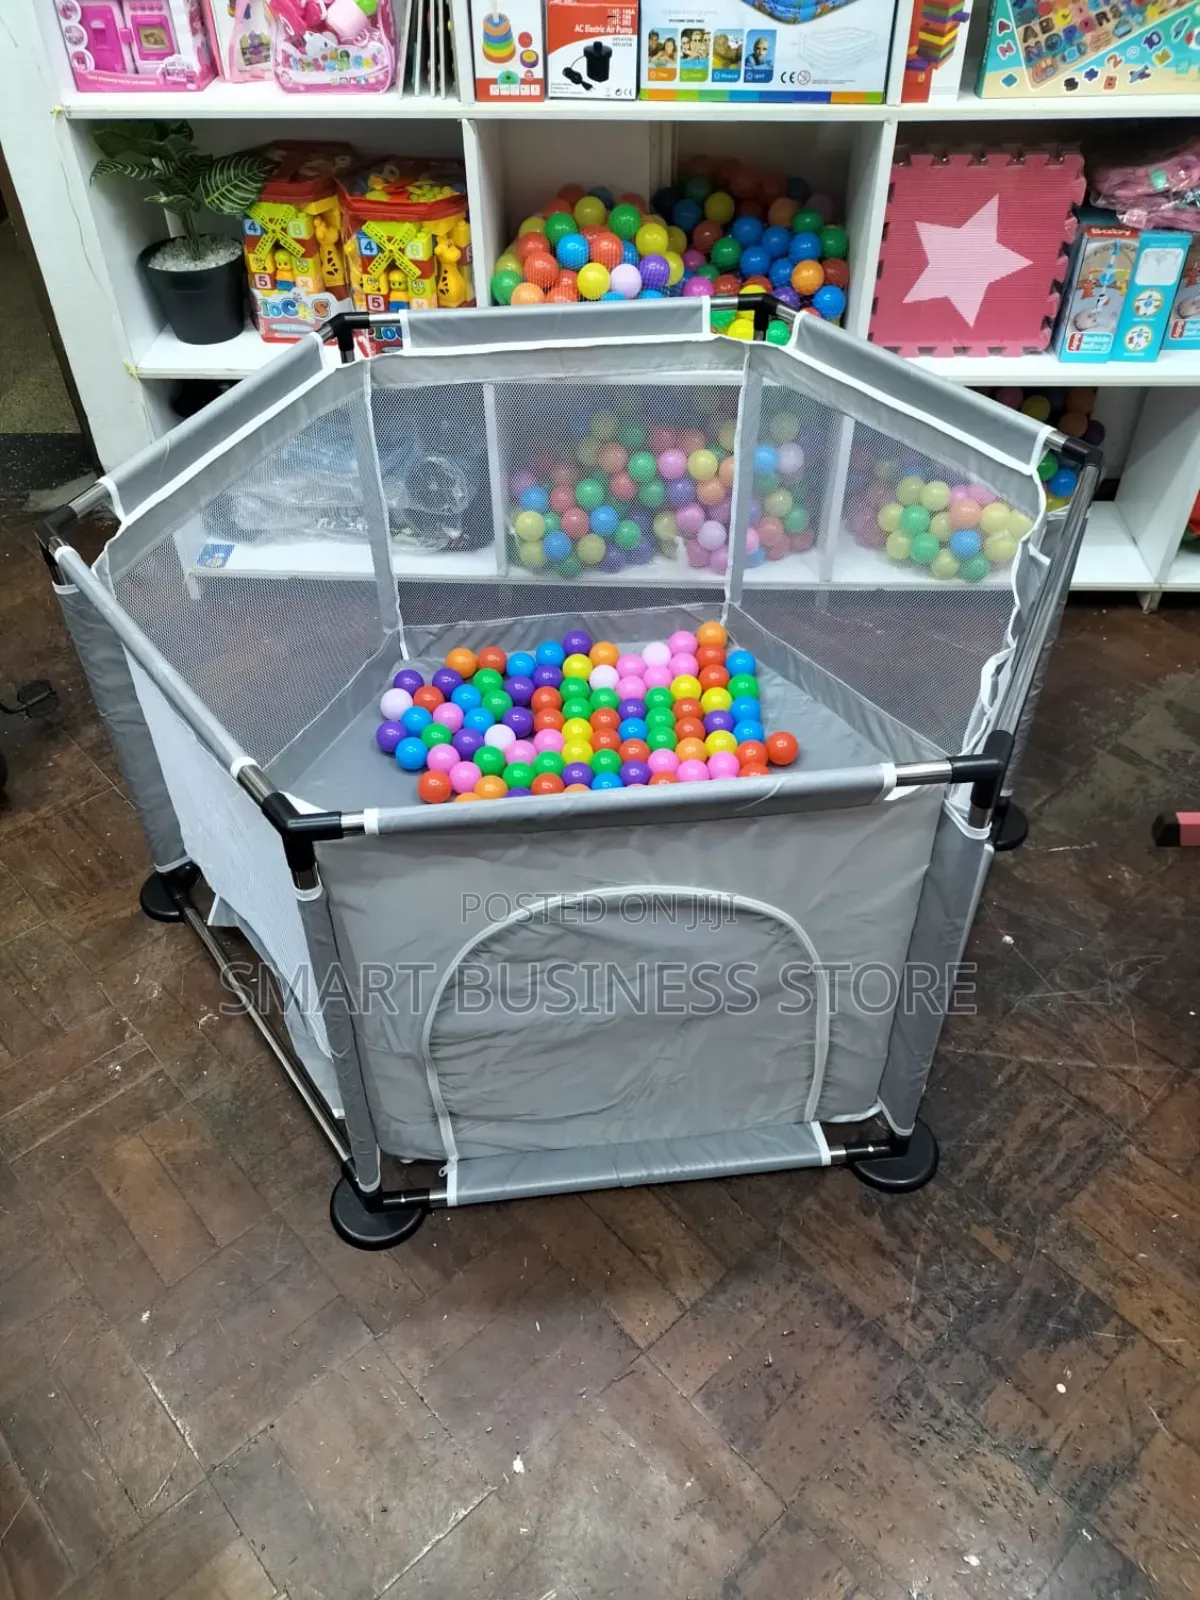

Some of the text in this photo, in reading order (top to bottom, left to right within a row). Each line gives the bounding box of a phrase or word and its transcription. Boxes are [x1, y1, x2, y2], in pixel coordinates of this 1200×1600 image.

[574, 24, 633, 35] AC Electric Air Pump
[248, 222, 258, 233] 4
[363, 240, 375, 253] 4
[258, 275, 268, 288] 5
[370, 296, 382, 309] 5
